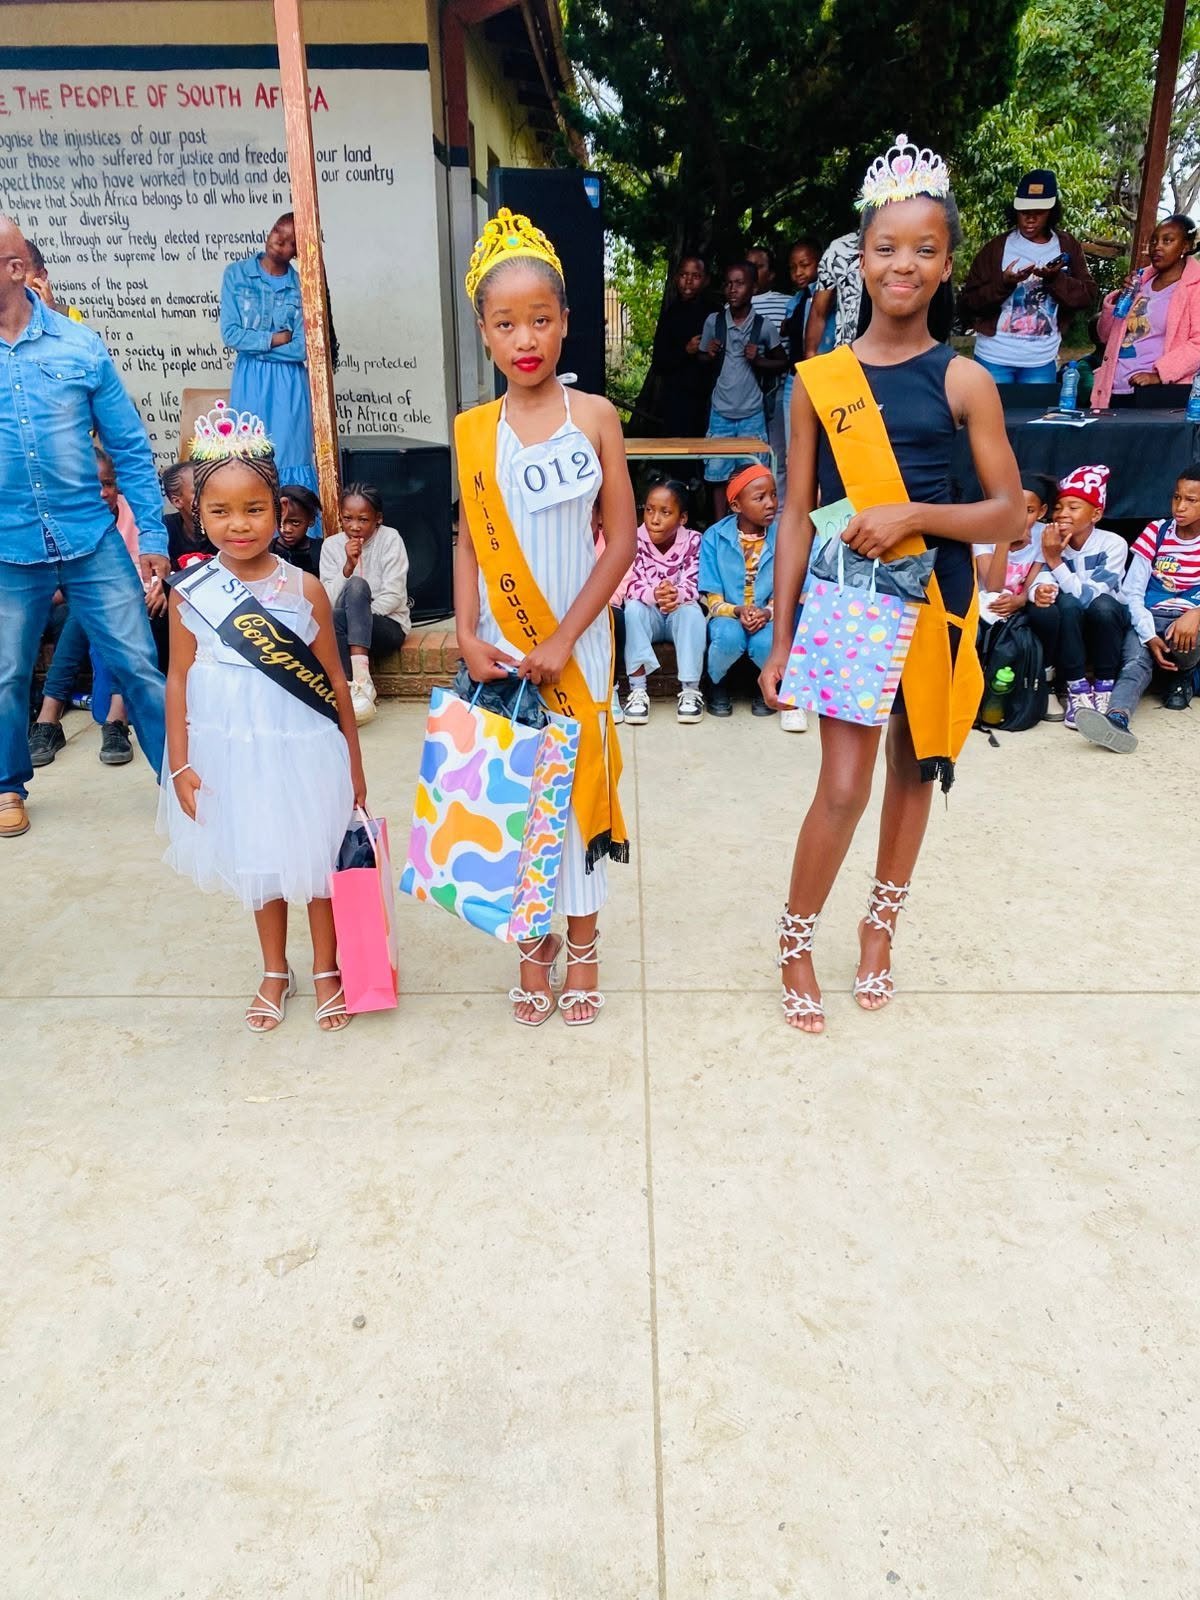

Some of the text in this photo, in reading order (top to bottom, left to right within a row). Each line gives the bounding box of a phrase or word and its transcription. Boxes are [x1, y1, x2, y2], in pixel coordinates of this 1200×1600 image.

[13, 86, 52, 110] THE
[60, 83, 139, 108] PEOPLE
[147, 84, 168, 108] OF
[177, 82, 241, 108] SOUTH
[39, 129, 58, 147] the
[63, 130, 121, 151] injustices
[131, 124, 143, 144] of
[150, 131, 171, 144] our
[179, 128, 207, 151] past
[27, 152, 60, 169] those
[68, 150, 95, 167] who
[103, 148, 152, 166] suffered
[157, 147, 174, 164] for
[178, 148, 213, 169] justice
[218, 147, 239, 163] and
[316, 150, 337, 162] our
[343, 144, 372, 162] land
[31, 172, 65, 190] those
[71, 173, 97, 190] who
[102, 171, 134, 188] have
[141, 170, 184, 187] worked
[193, 169, 206, 187] to
[210, 168, 239, 185] build
[245, 168, 267, 184] and
[321, 169, 339, 182] our
[346, 163, 394, 185] country
[7, 194, 42, 210] believe
[44, 194, 67, 209] that
[70, 190, 101, 208] South
[105, 190, 137, 206] Africa
[142, 190, 182, 210] belongs
[186, 189, 198, 204] to
[203, 188, 217, 204] all
[221, 189, 245, 204] who
[249, 188, 268, 204] live
[273, 189, 283, 204] in
[28, 214, 39, 226] in
[49, 215, 67, 226] our
[80, 210, 130, 230] diversity
[60, 230, 101, 249] through
[106, 234, 123, 245] our
[128, 231, 157, 250] freely
[164, 229, 200, 244] elected
[77, 252, 88, 263] as
[91, 249, 108, 263] the
[114, 252, 155, 268] supreme
[187, 246, 196, 261] of
[201, 247, 218, 261] the
[91, 277, 101, 290] of
[106, 278, 122, 290] the
[79, 294, 115, 309] society
[92, 305, 157, 319] fundamental
[161, 307, 197, 319] human
[105, 326, 122, 341] for
[125, 343, 165, 360] society
[170, 344, 182, 357] in
[186, 342, 217, 357] which
[122, 357, 132, 371] of
[138, 358, 157, 371] the
[162, 358, 197, 379] people
[200, 357, 223, 370] and
[364, 356, 418, 375] protected
[141, 390, 180, 407] of life
[397, 389, 412, 406] of
[357, 405, 398, 422] Africa
[403, 408, 432, 424] able
[830, 397, 866, 434] 2nd
[338, 419, 352, 434] of
[524, 452, 595, 493] 012
[473, 471, 500, 551] Miss
